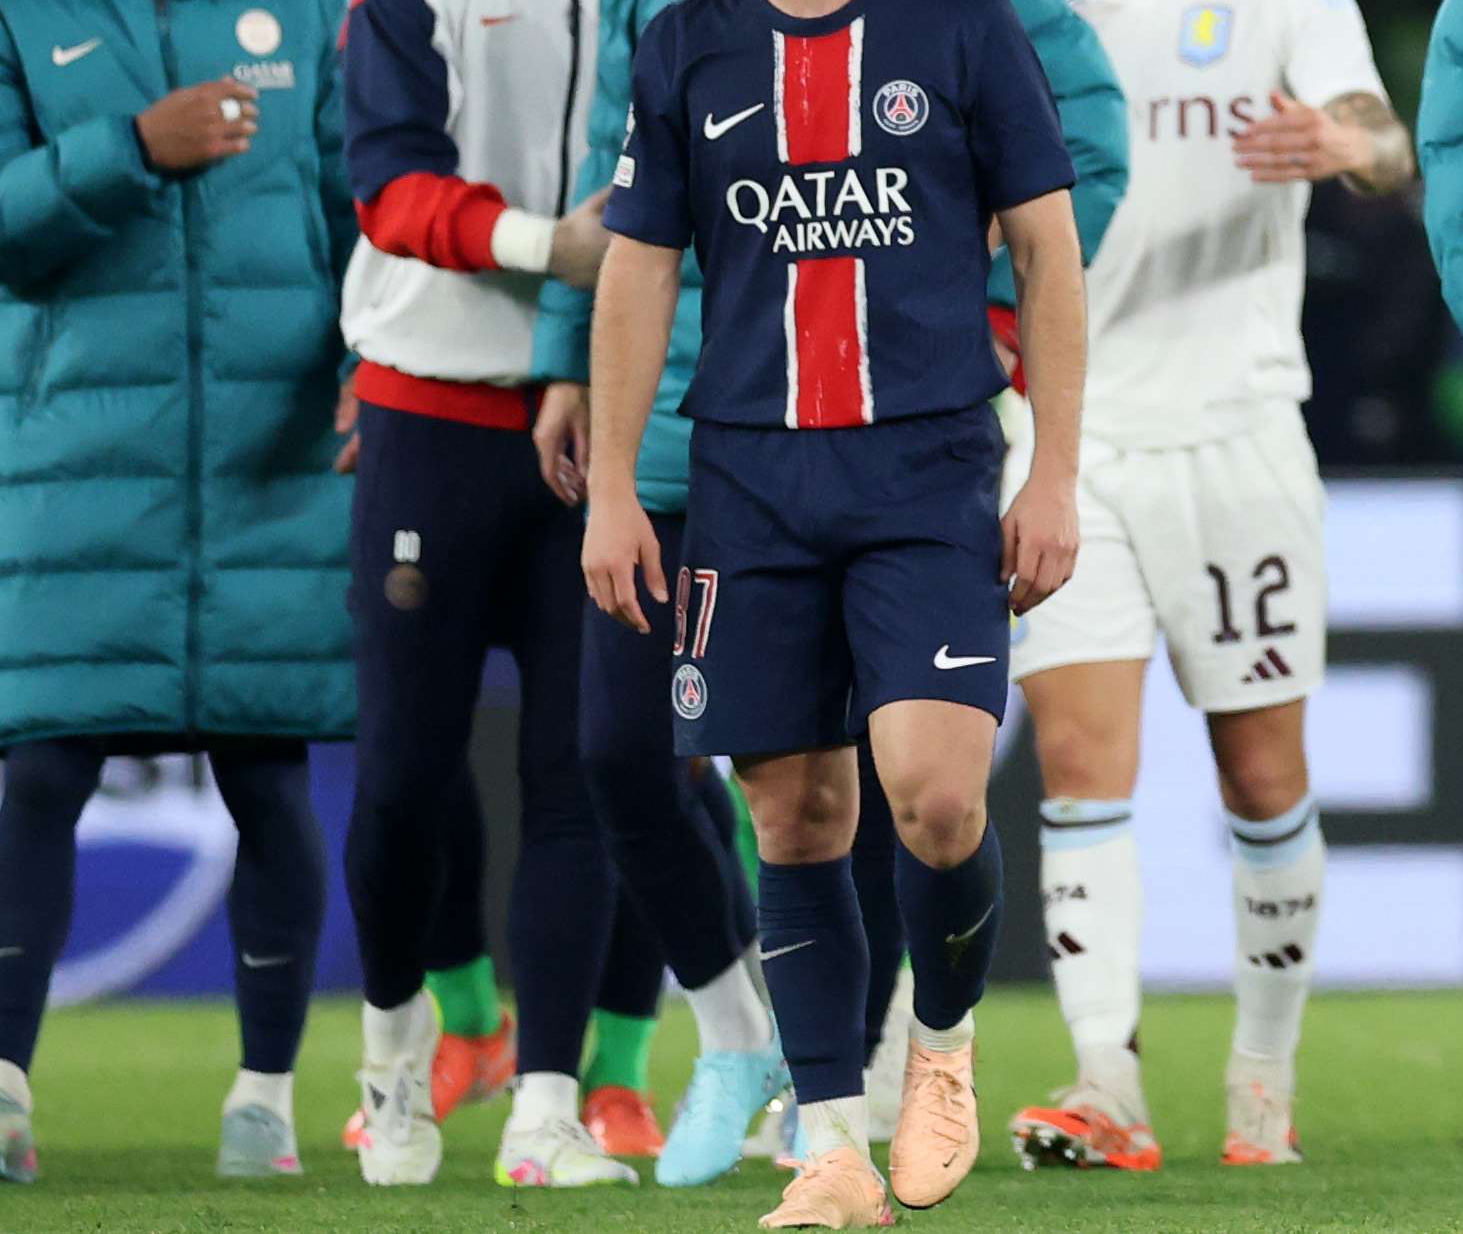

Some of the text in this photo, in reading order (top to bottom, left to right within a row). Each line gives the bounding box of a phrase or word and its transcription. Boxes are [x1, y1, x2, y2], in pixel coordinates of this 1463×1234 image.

[726, 167, 912, 233] QATAR
[773, 217, 915, 253] AIRWAYS
[1205, 553, 1297, 645] 12
